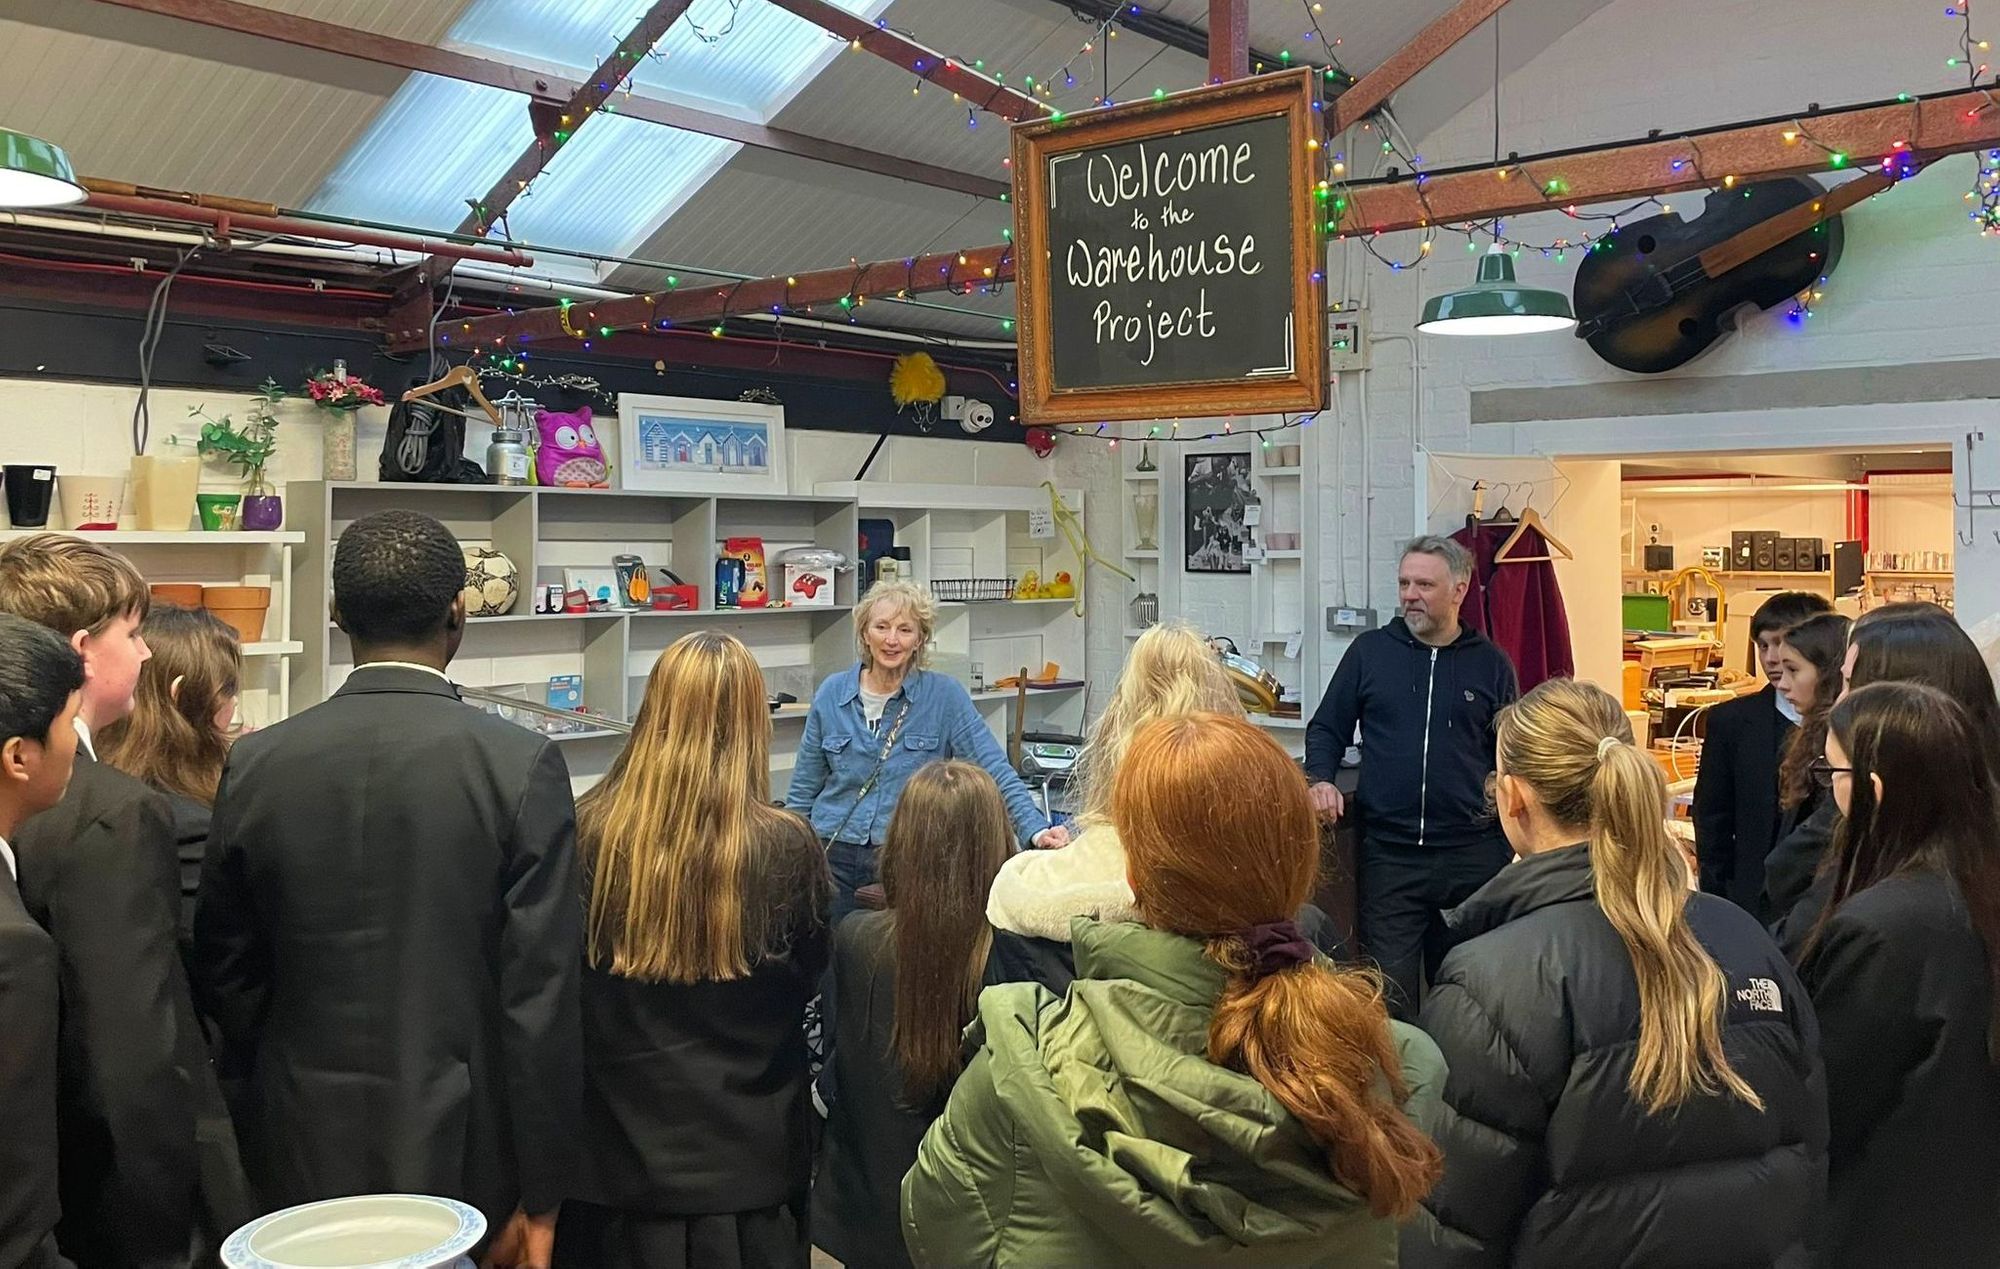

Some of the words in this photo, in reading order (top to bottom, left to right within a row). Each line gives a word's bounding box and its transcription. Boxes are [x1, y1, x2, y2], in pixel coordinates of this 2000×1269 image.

[1087, 142, 1256, 207] Welcome
[1130, 207, 1149, 230] to
[1160, 199, 1195, 228] the
[1066, 233, 1264, 288] Warehouse
[1092, 288, 1216, 367] Project
[1736, 988, 1771, 1001] NORTH
[1749, 978, 1769, 990] THE
[1750, 1000, 1773, 1011] FACE
